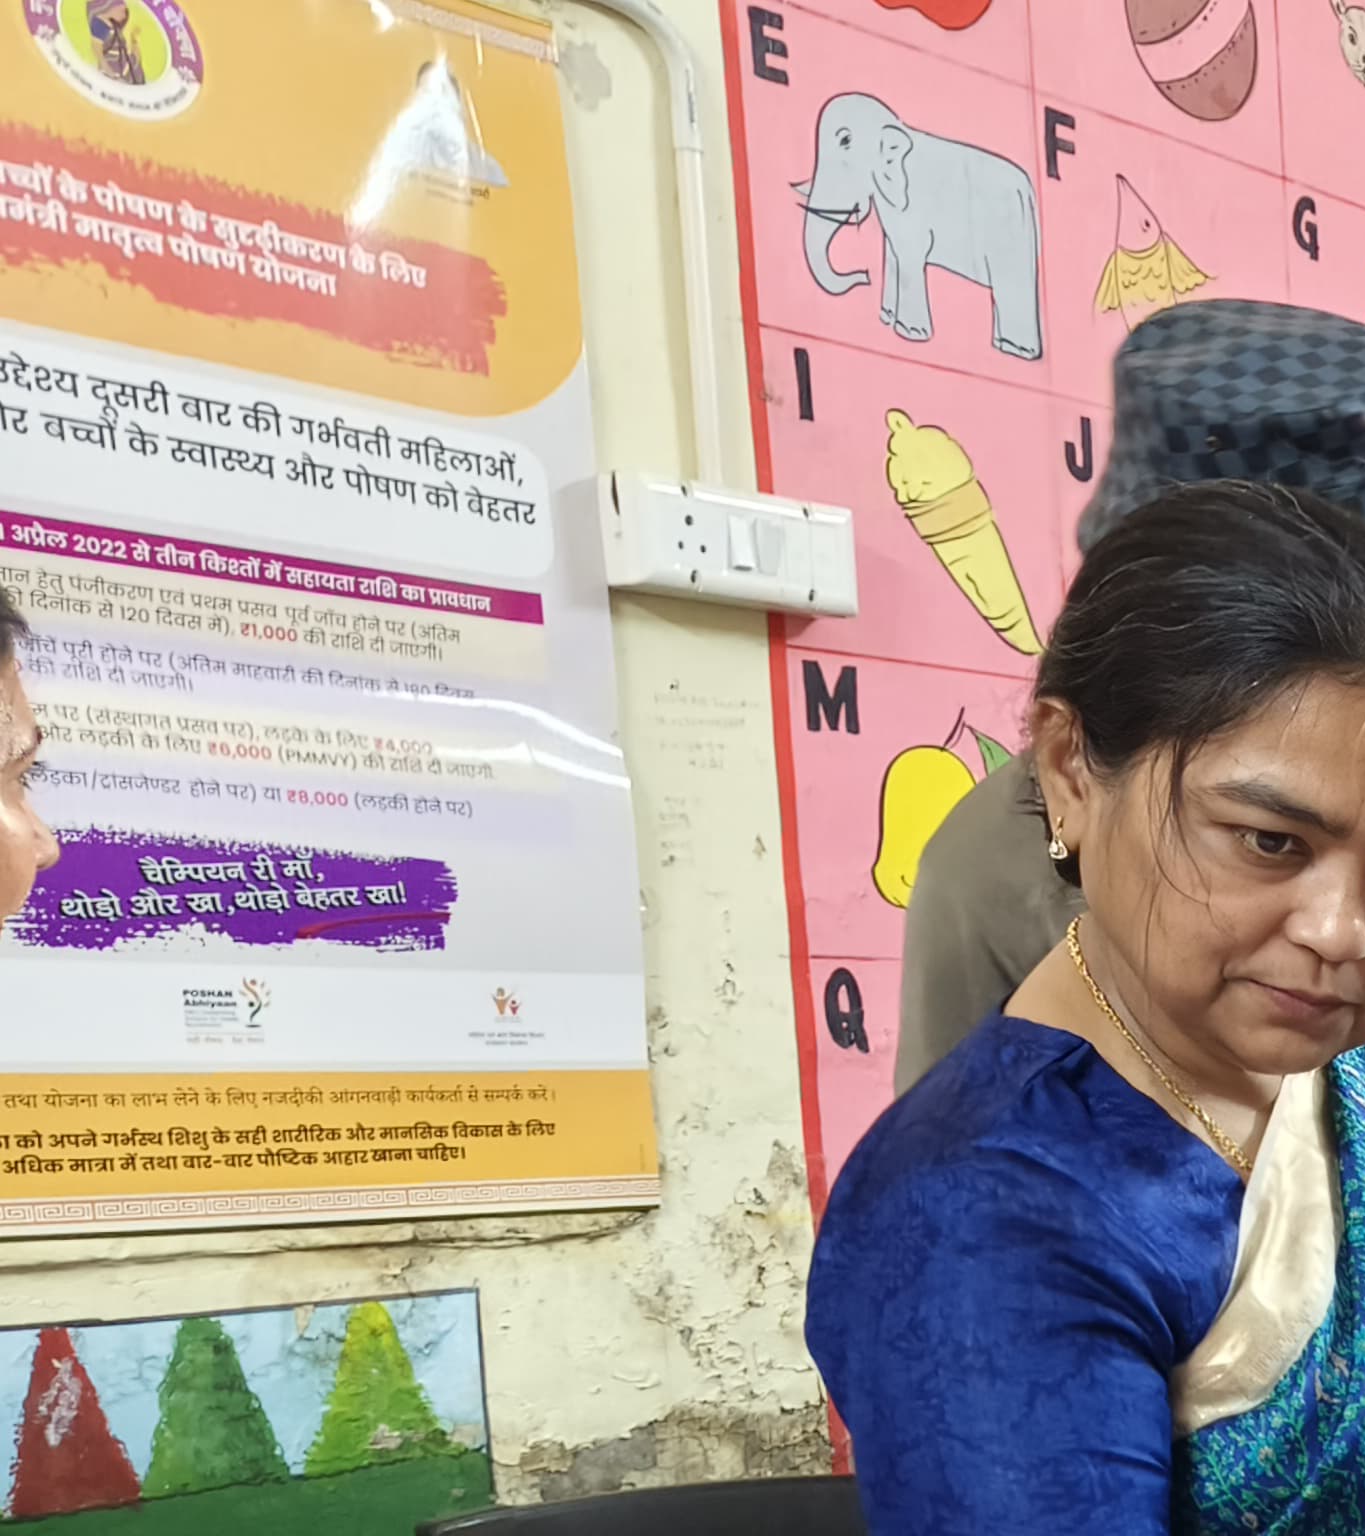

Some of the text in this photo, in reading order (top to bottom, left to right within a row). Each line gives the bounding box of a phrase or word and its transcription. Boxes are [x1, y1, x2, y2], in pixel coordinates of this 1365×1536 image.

[748, 6, 789, 85] E
[1044, 106, 1076, 181] F
[57, 168, 88, 203] के
[92, 180, 173, 226] पोषण
[177, 200, 206, 232] के
[380, 251, 427, 288] लिए
[1292, 196, 1319, 261] G
[168, 231, 246, 275] पोषण
[249, 253, 336, 296] योजना
[794, 348, 814, 421] I
[87, 380, 170, 419] दूसरी
[238, 401, 281, 437] की
[289, 417, 391, 458] गर्भवती
[398, 436, 523, 487] महिलाओं,
[1064, 416, 1093, 482] J
[125, 421, 159, 456] के
[167, 436, 275, 479] स्वास्थ्य
[285, 452, 335, 490] और
[343, 464, 416, 504] पोषण
[423, 481, 458, 513] को
[38, 569, 64, 595] हेतु
[69, 574, 153, 601] पंजीकरण
[192, 594, 232, 614] प्रथम
[237, 598, 277, 619] प्रसव
[285, 605, 308, 626] पूर्व
[352, 615, 380, 634] होने
[384, 620, 406, 637] पर
[73, 535, 127, 560] 2022
[130, 539, 151, 563] से
[154, 543, 195, 569] तीन
[200, 549, 261, 579] किश्तों
[264, 560, 283, 582] में
[287, 566, 355, 593] सहायता
[359, 576, 398, 599] राशि
[402, 583, 425, 603] का
[429, 588, 491, 613] प्रावधान
[98, 599, 113, 618] से
[120, 606, 150, 624] 120
[303, 628, 325, 647] की
[331, 634, 364, 652] राशि
[370, 637, 385, 654] दी
[138, 649, 162, 667] पर
[301, 667, 324, 688] की
[802, 660, 860, 735] M
[130, 887, 181, 917] और
[295, 883, 362, 910] बेहतर
[138, 856, 246, 885] चैम्पियन
[252, 854, 275, 882] री
[183, 989, 232, 997] POSHAN
[823, 967, 869, 1054] Q
[44, 1088, 97, 1108] योजना
[104, 1092, 127, 1108] का
[132, 1092, 167, 1107] लाभ
[173, 1087, 199, 1107] लेने
[205, 1087, 221, 1107] के
[226, 1087, 257, 1109] लिए
[262, 1086, 323, 1107] नजदीकी
[468, 1085, 479, 1102] से
[3, 1155, 63, 1175] अधिक
[68, 1157, 115, 1173] मात्रा
[118, 1154, 141, 1171] में
[142, 1155, 177, 1171] तथा
[323, 1149, 368, 1166] आहार
[371, 1147, 413, 1163] खाना
[416, 1142, 466, 1161] चाहिए।
[16, 1130, 43, 1149] को
[49, 1129, 97, 1149] अपने
[102, 1128, 162, 1148] गर्भस्थ
[168, 1127, 209, 1151] शिशु
[211, 1127, 230, 1145] के
[234, 1126, 267, 1144] सही
[272, 1124, 341, 1143] शारीरिक
[347, 1122, 375, 1141] और
[380, 1121, 448, 1140] मानसिक
[452, 1120, 503, 1139] विकास
[507, 1120, 522, 1136] के
[525, 1119, 556, 1136] लिए
